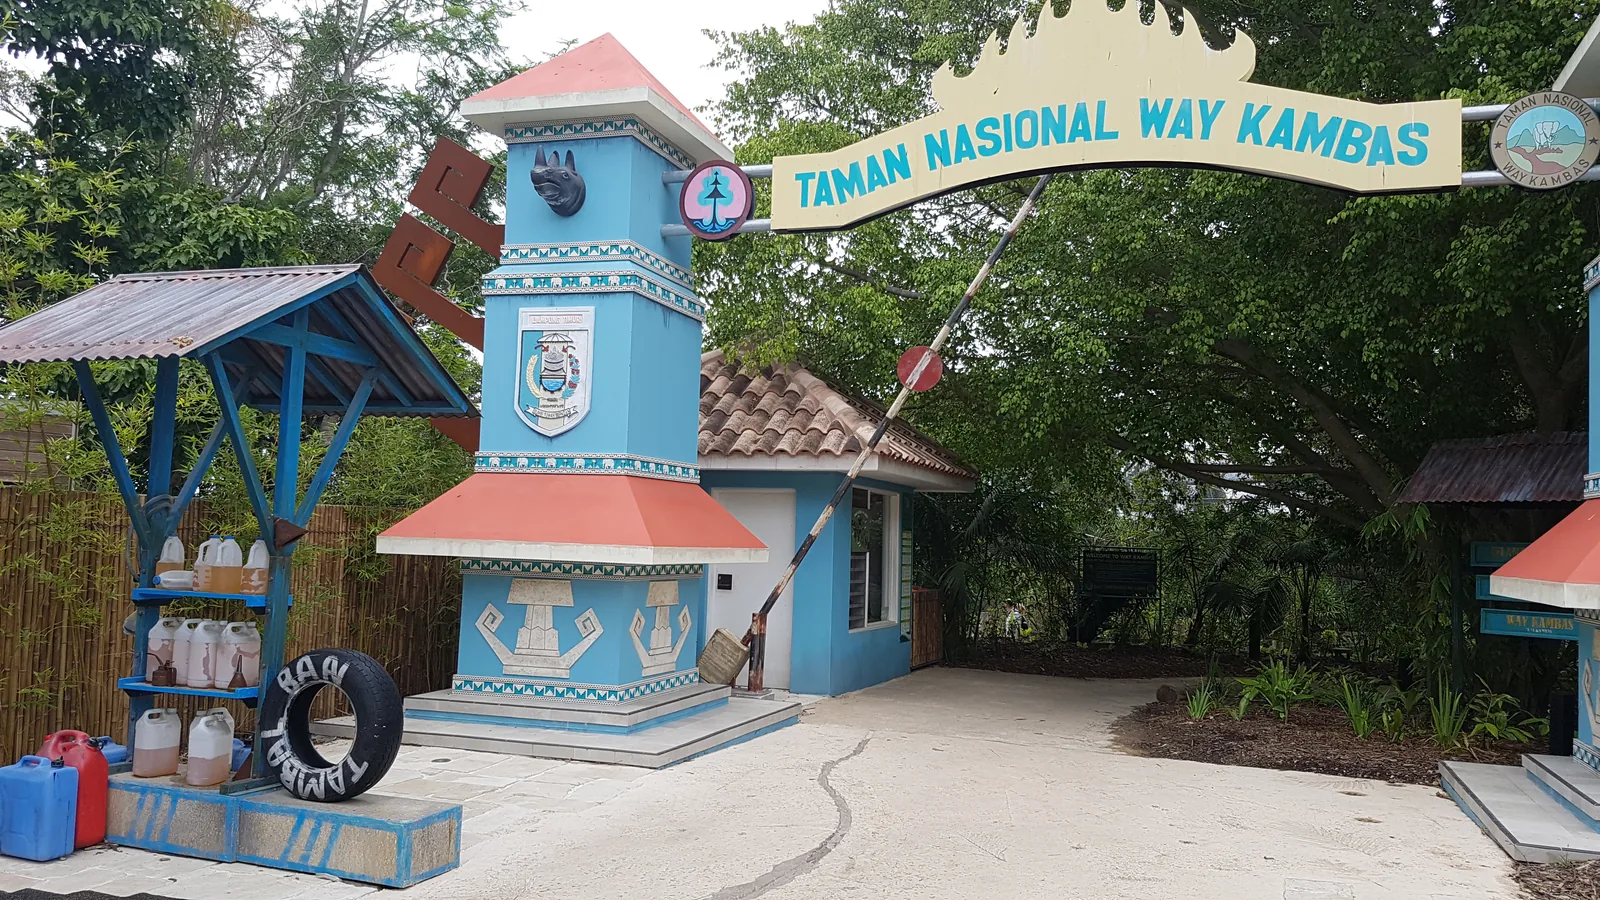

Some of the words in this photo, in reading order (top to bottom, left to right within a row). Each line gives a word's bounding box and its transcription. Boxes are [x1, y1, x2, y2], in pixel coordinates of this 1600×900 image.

[1496, 96, 1537, 129] TAMAN
[1543, 94, 1595, 127] NASIONAL
[795, 143, 912, 208] TAMAN
[923, 100, 1119, 171] NASIONAL
[1139, 97, 1226, 140] WAY
[1236, 103, 1430, 167] KAMBAS
[1503, 161, 1527, 182] WAY
[1529, 159, 1590, 186] KAMBAS
[1507, 614, 1528, 626] WAY
[1531, 616, 1574, 630] KAMBAS
